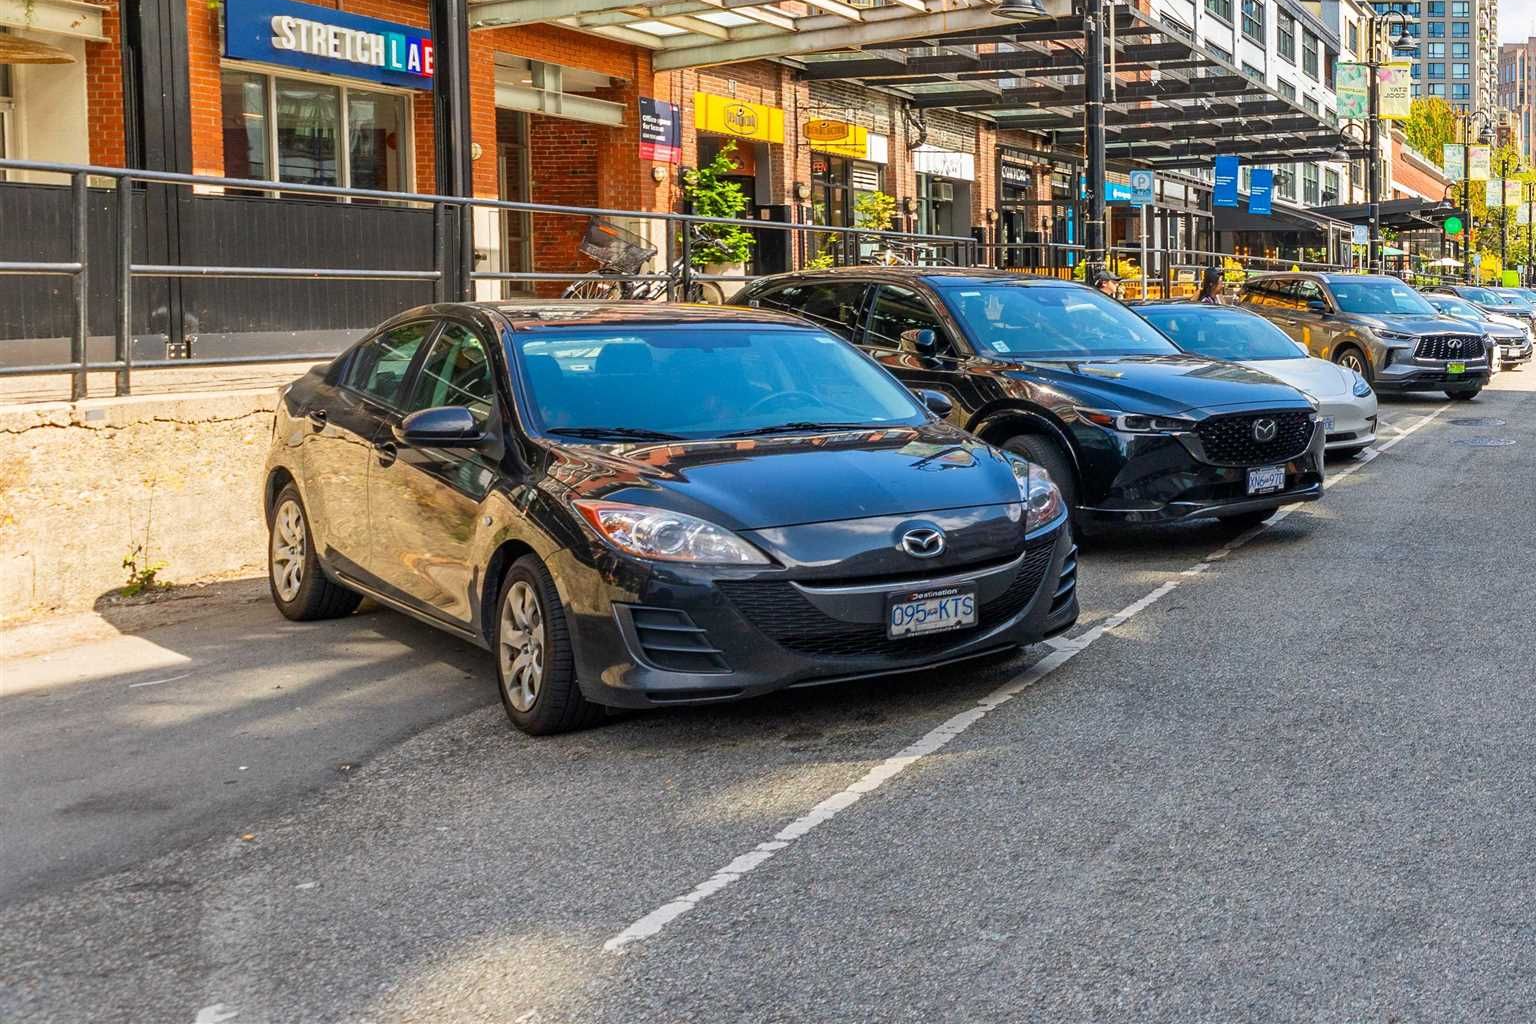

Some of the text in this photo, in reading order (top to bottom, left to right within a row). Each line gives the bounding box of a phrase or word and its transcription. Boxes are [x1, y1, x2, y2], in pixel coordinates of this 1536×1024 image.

[271, 15, 386, 67] STRETCH
[891, 596, 974, 627] 095 KTS
